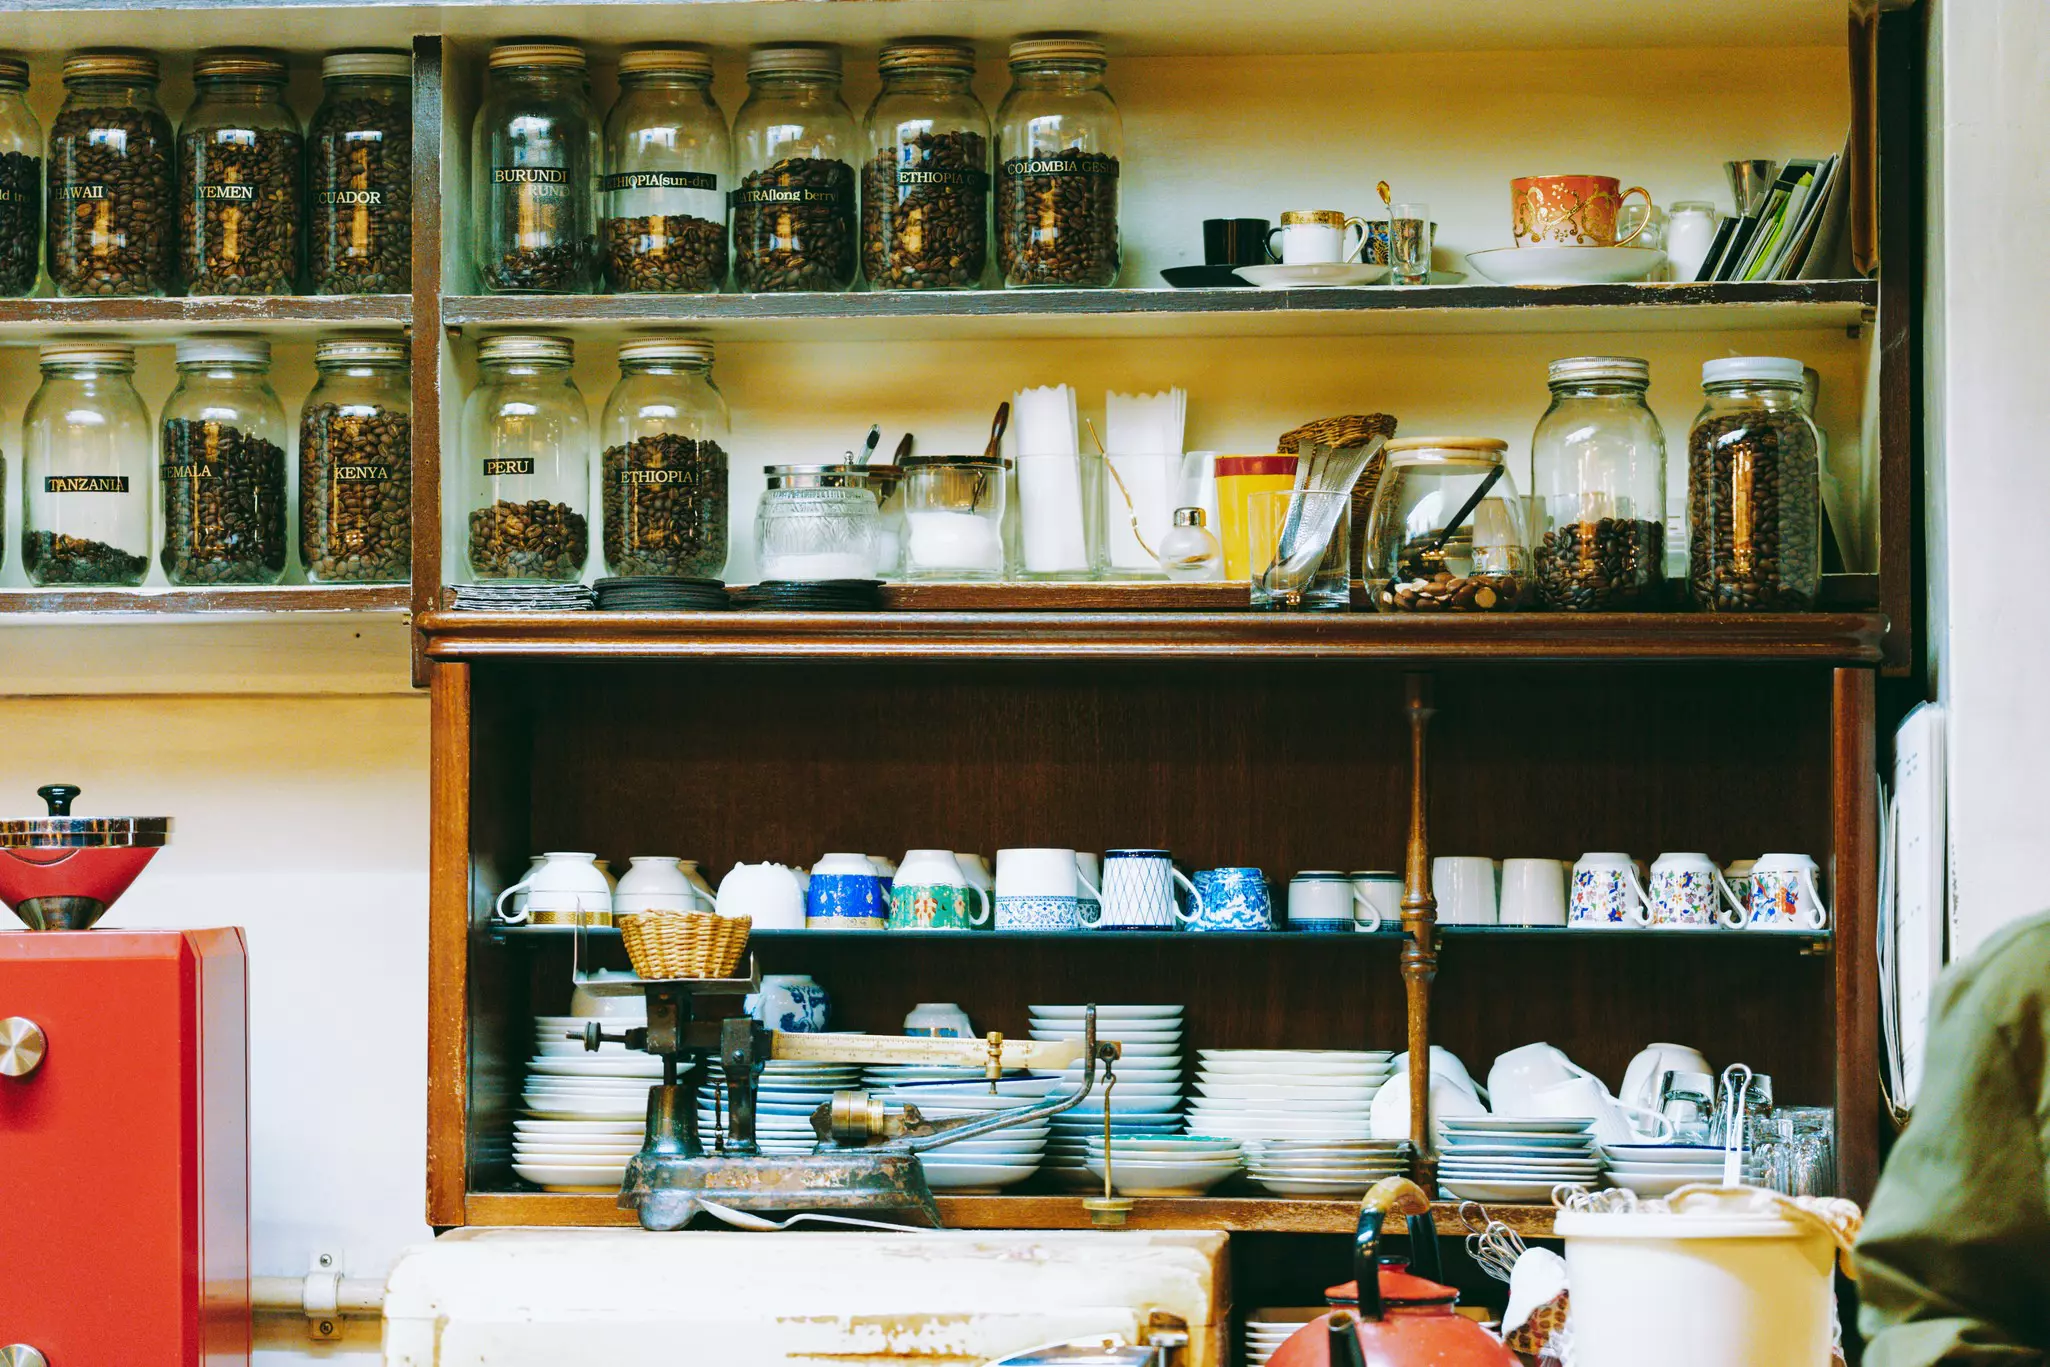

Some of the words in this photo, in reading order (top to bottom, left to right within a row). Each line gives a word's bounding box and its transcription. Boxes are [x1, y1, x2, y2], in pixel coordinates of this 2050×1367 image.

[1007, 160, 1078, 175] COLOMBIA
[495, 169, 567, 183] BURUNDI
[900, 171, 964, 184] ETHIOPIA
[55, 185, 103, 199] HAWAII
[198, 185, 253, 199] YEMEN
[334, 466, 388, 479] KENYA
[486, 460, 529, 474] PERU
[621, 470, 693, 483] ETHIOPIA
[48, 478, 125, 492] TANZANIA
